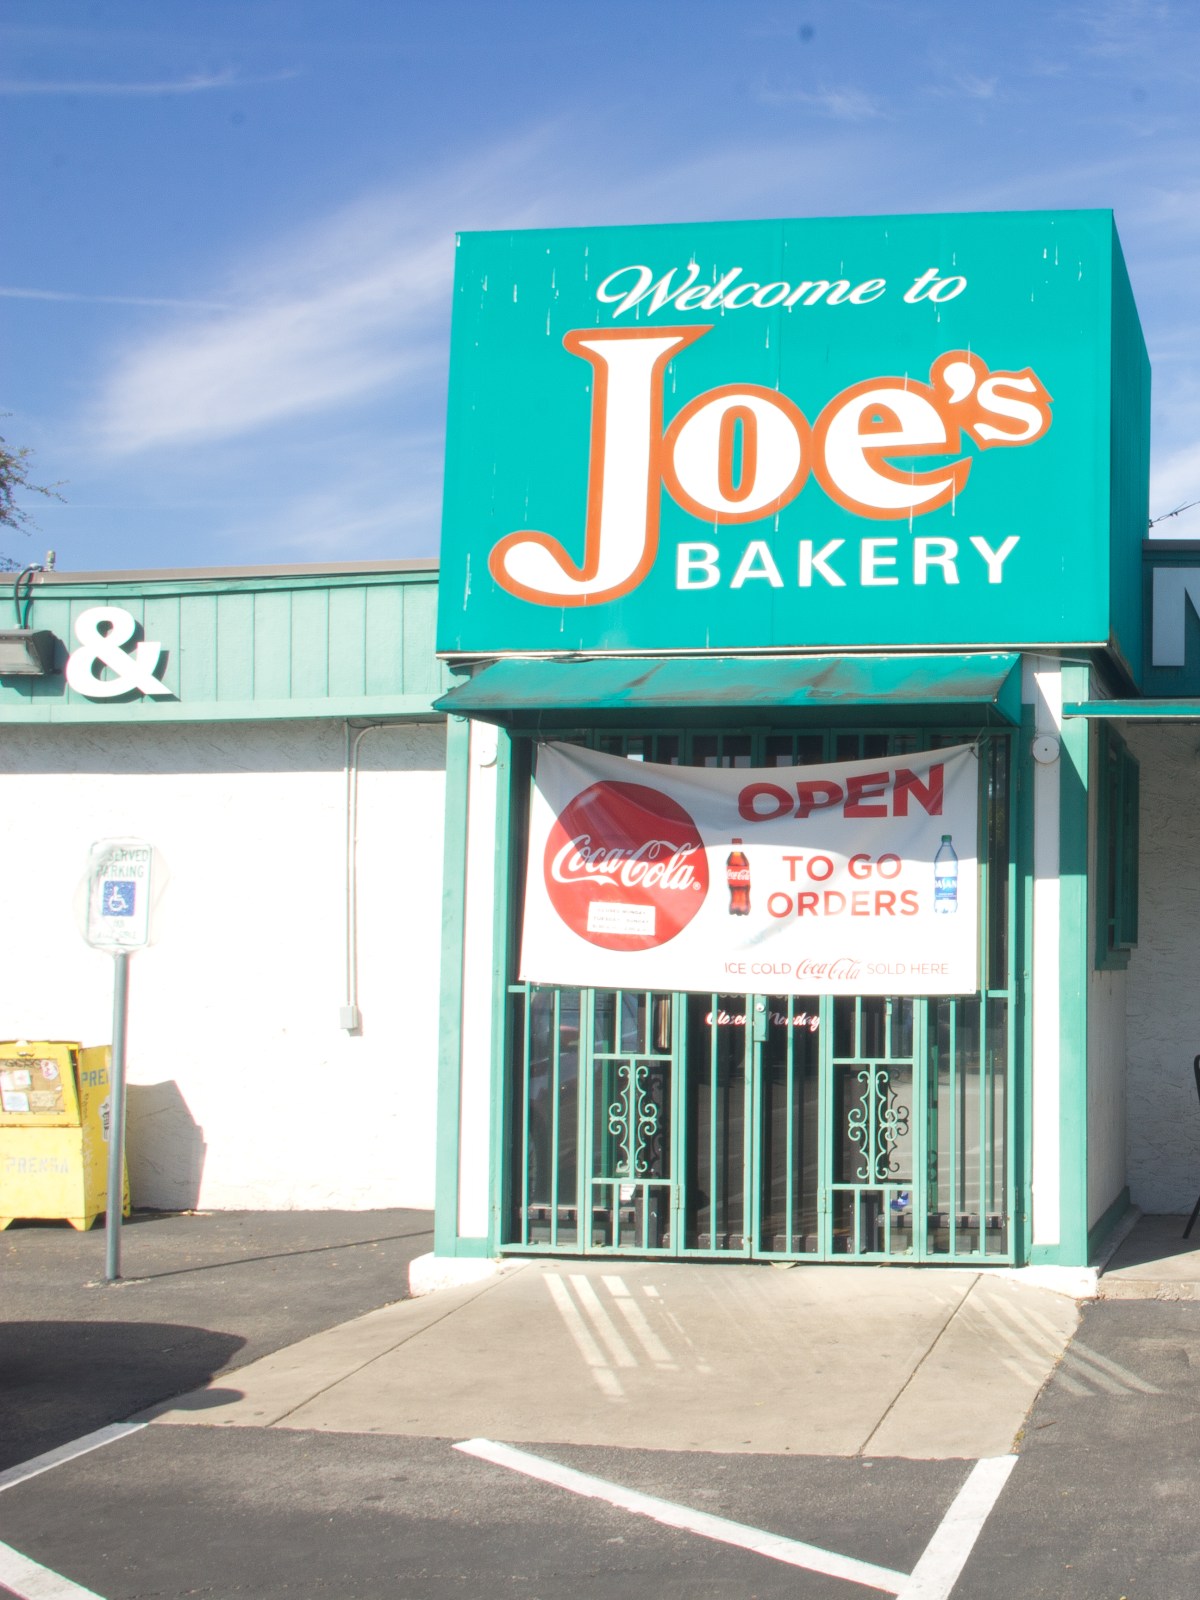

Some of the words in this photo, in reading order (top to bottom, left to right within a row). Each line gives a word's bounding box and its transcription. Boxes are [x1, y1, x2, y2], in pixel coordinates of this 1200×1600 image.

[596, 263, 886, 319] Welcome
[904, 267, 967, 303] to
[488, 325, 1053, 607] Joe's
[675, 535, 1020, 589] BAKERY
[66, 606, 174, 697] &
[738, 763, 944, 822] OPEN
[103, 847, 149, 862] SERVED
[783, 855, 833, 882] TO
[848, 853, 902, 880] GO
[767, 890, 919, 918] ORDERS
[725, 961, 746, 975] ICE
[751, 962, 792, 975] COLD
[867, 962, 906, 976] SOLD
[911, 963, 949, 976] HERE
[81, 1068, 109, 1087] PRE
